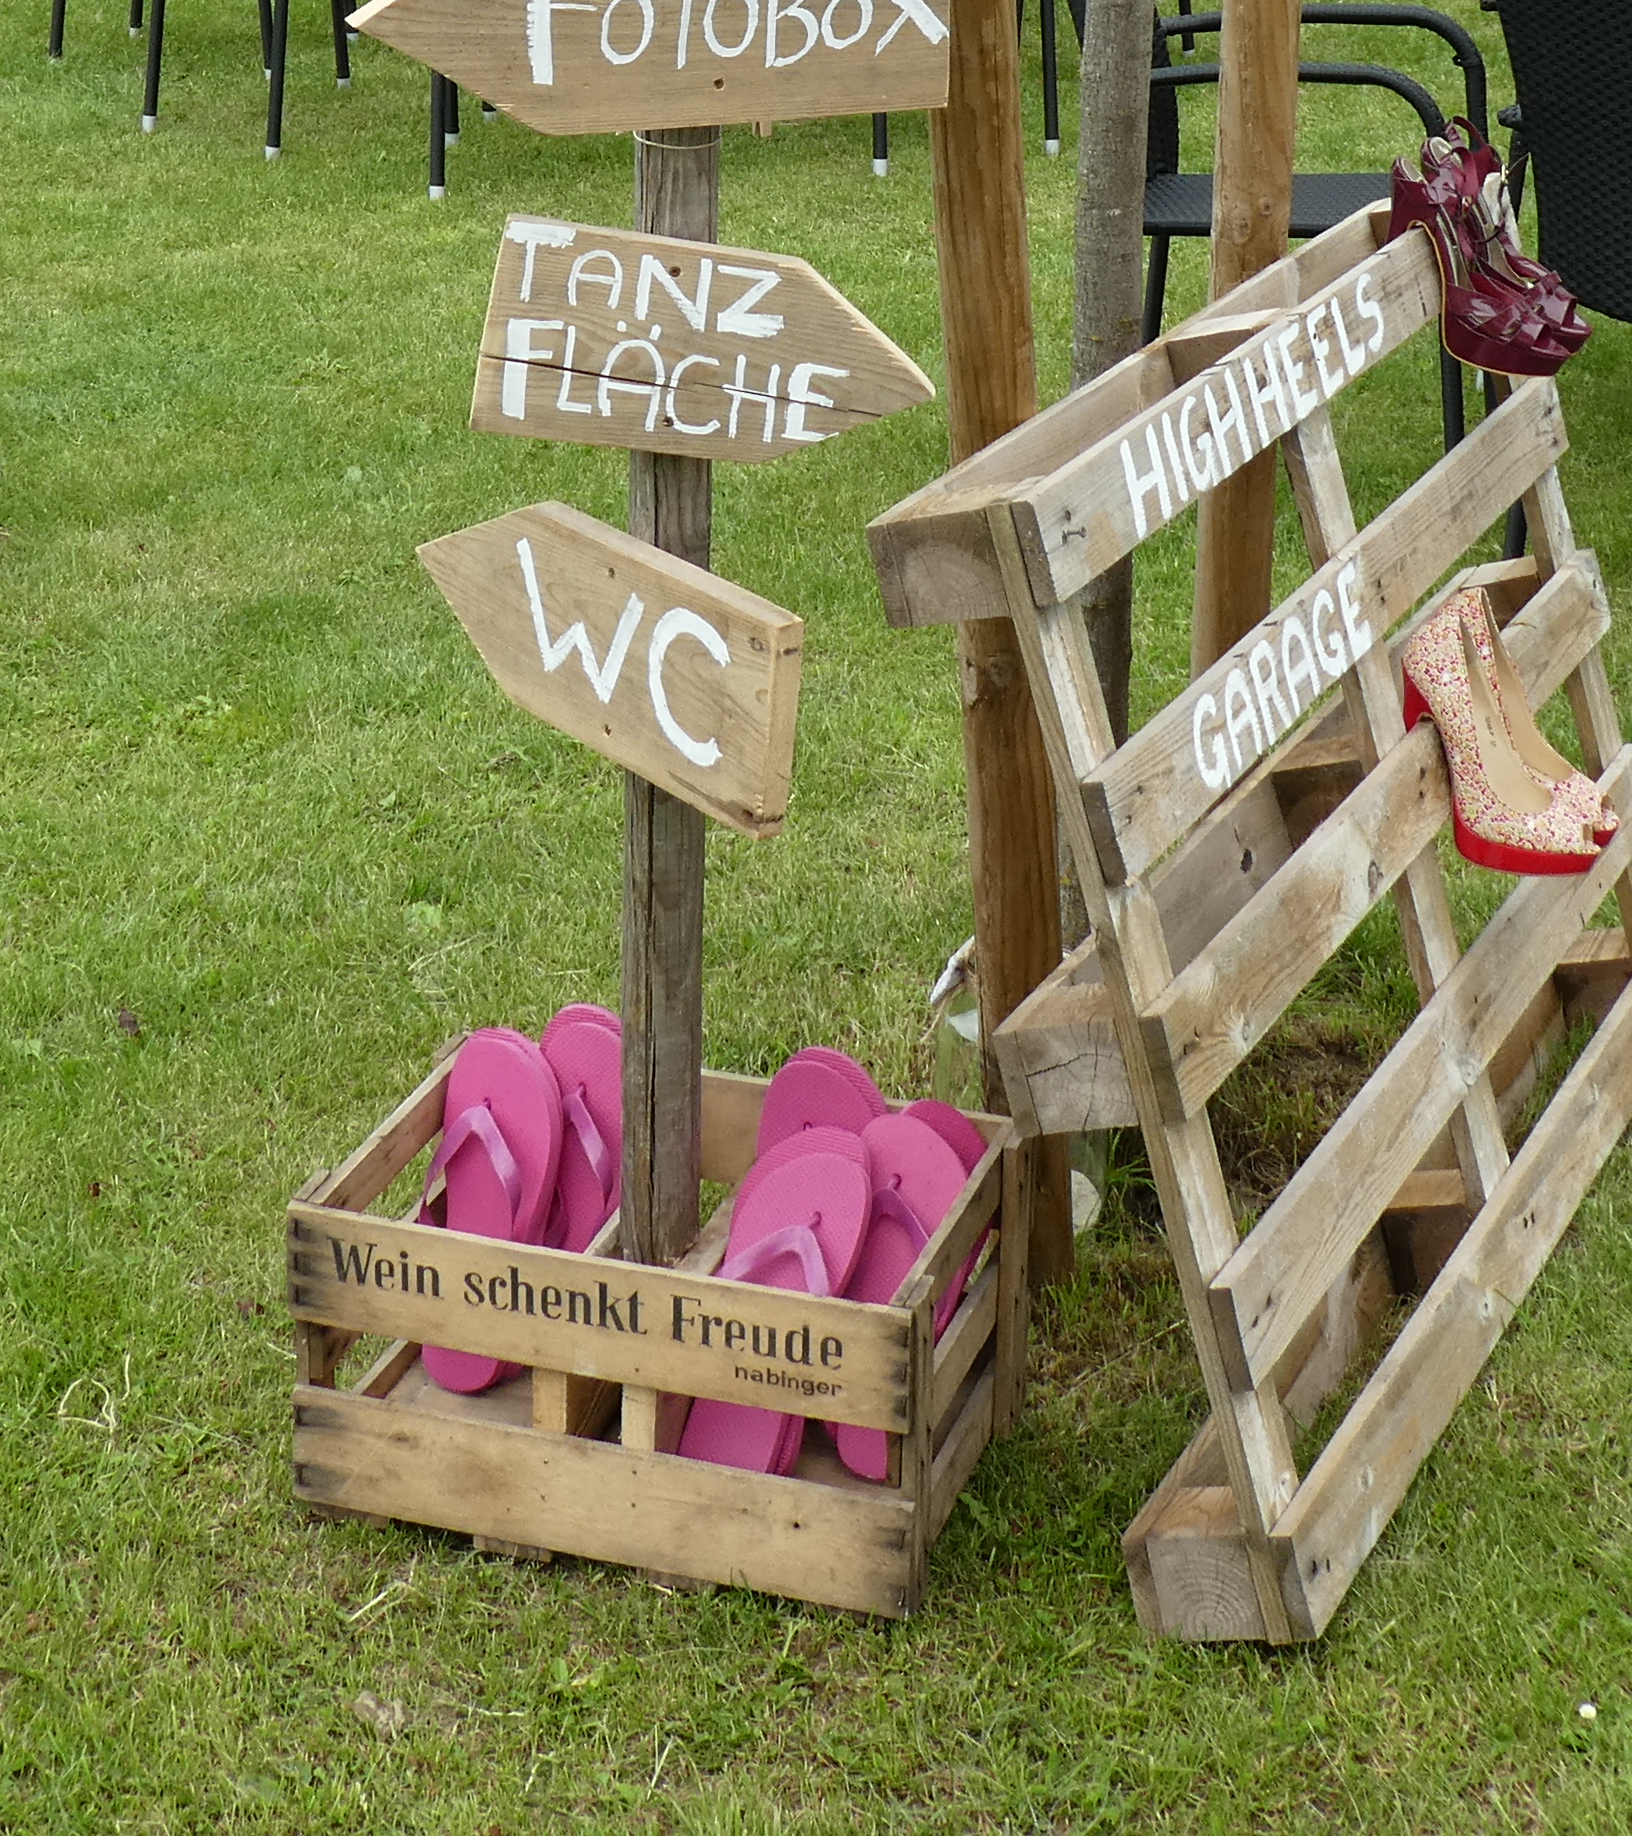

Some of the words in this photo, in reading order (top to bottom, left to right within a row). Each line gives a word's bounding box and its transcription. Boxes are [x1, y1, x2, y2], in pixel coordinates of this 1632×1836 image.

[506, 221, 785, 338] TANZ
[501, 318, 851, 443] FLÄCHE
[516, 537, 731, 766] WC
[1193, 563, 1373, 789] GARAGE
[328, 1237, 445, 1300] Wein
[464, 1265, 648, 1336] schenkt
[670, 1294, 844, 1371] Freude
[734, 1364, 843, 1397] nabinger
